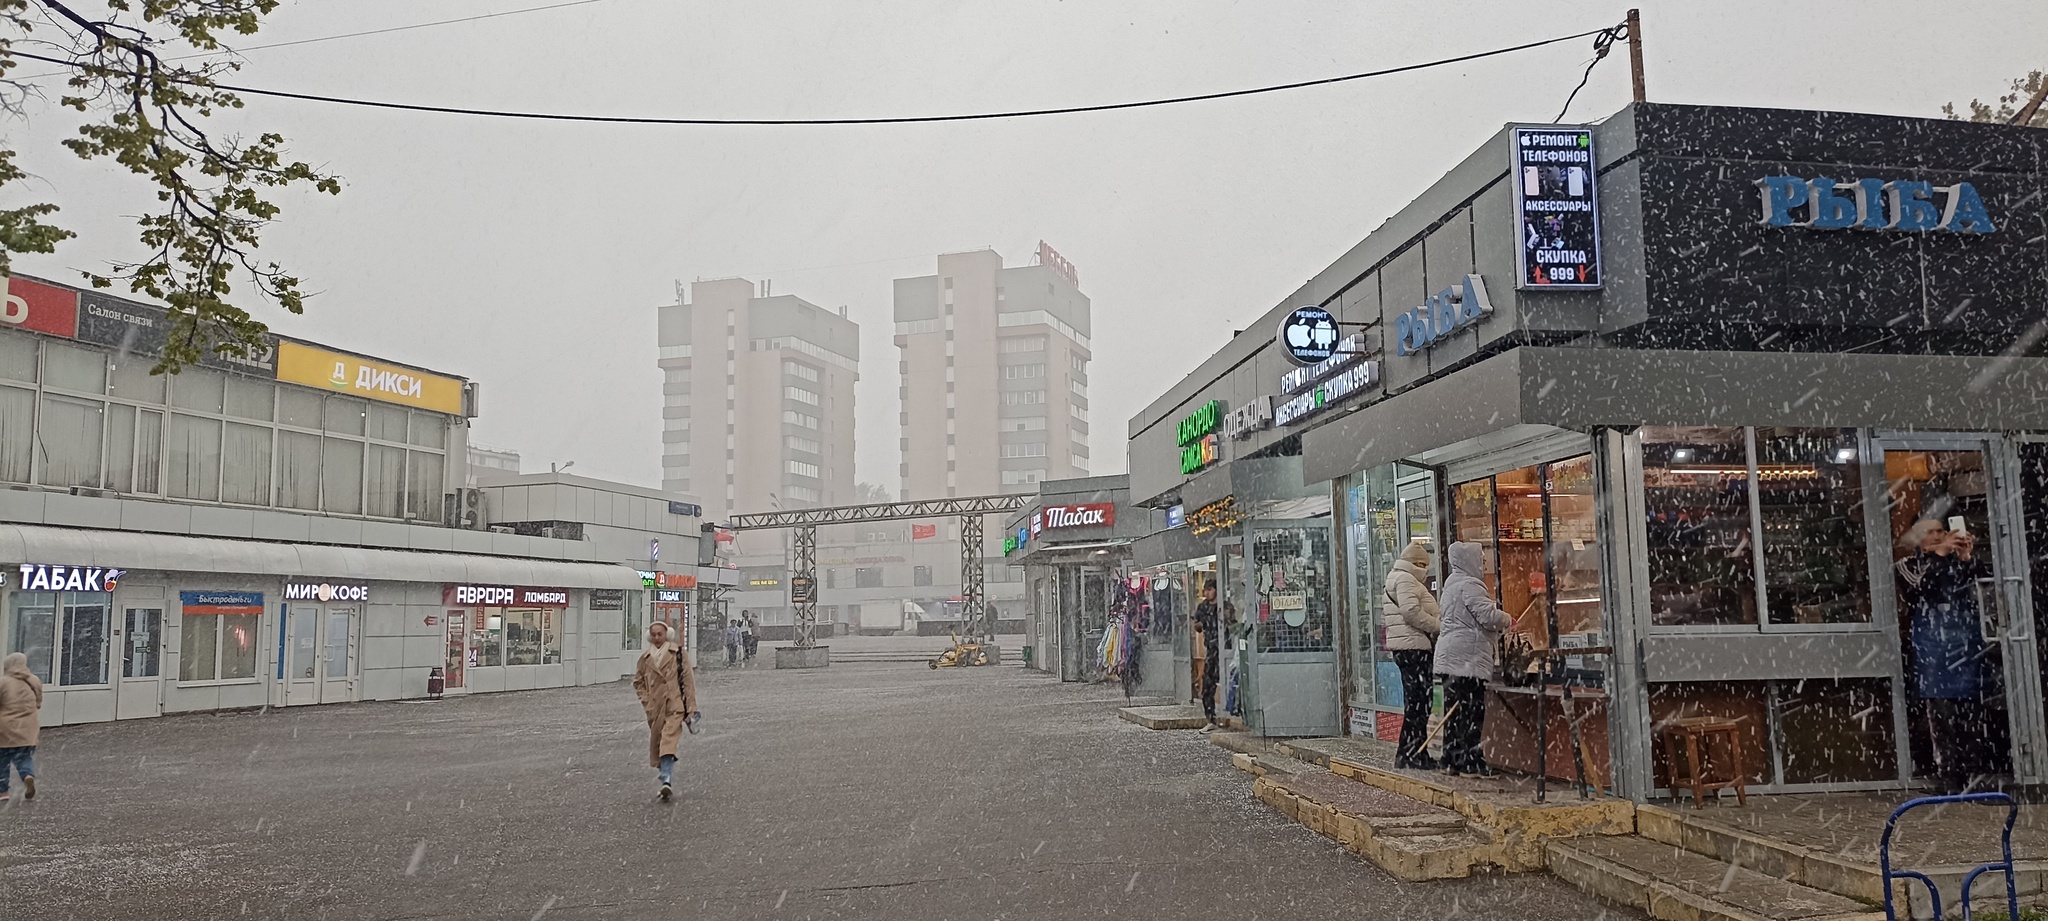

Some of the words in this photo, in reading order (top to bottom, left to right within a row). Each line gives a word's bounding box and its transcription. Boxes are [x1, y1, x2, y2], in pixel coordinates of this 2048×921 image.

[1532, 135, 1577, 146] РЕМОНТ
[1523, 150, 1588, 162] ТЕЛЕФОНОВ
[1526, 201, 1591, 211] АКСЕССУАРЫ
[1756, 176, 1996, 233] РЫБА
[1536, 250, 1586, 264] СКУПКА
[1550, 267, 1575, 280] 999
[88, 304, 121, 321] Салон
[123, 313, 152, 328] связи
[1296, 310, 1328, 319] РЕМОНТ
[1395, 274, 1490, 357] РЫБА
[1293, 348, 1330, 357] ТЕЛЕФОНОВ
[356, 365, 422, 398] ДИКСИ
[1275, 388, 1316, 427] АКСЕССУАРЫ
[1324, 369, 1354, 402] СКУПКА
[1353, 360, 1370, 389] 999
[1176, 399, 1216, 447] ХАНОРДО
[1223, 395, 1271, 439] ОДЕЖДА
[1046, 507, 1105, 528] Табак
[20, 564, 101, 591] ТАБАК
[286, 583, 319, 599] МИР
[330, 585, 368, 600] КОФЕ
[457, 587, 514, 604] АВРОРА
[524, 592, 566, 603] ЛОМБАРД
[659, 591, 680, 601] ТАБАК
